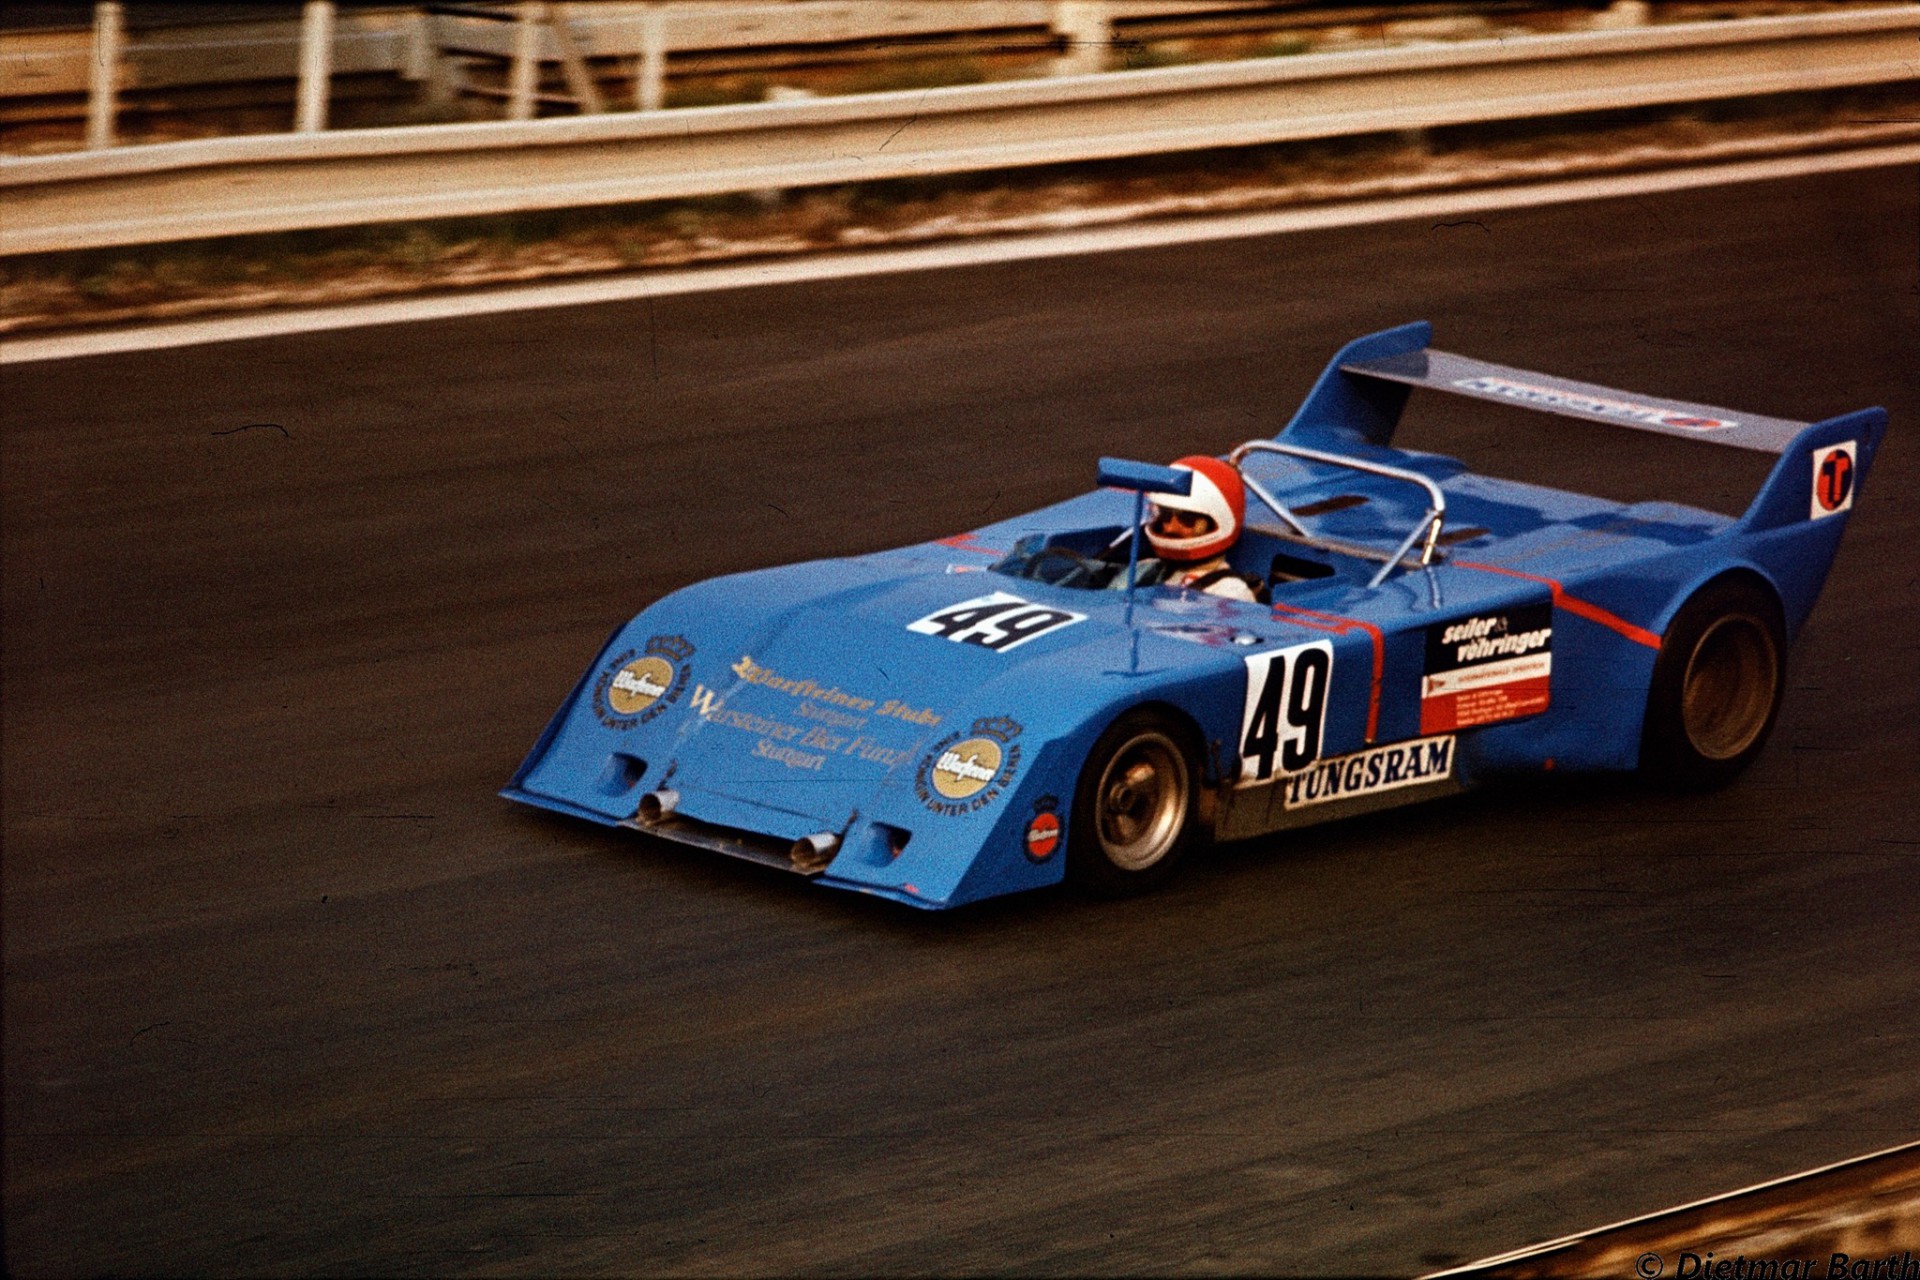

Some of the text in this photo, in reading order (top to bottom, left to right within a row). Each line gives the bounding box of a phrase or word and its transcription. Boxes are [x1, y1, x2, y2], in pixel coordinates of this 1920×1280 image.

[930, 602, 1074, 649] 49
[1442, 618, 1497, 644] seiler
[1243, 648, 1330, 780] 49
[1289, 738, 1450, 803] TUNGSRAM
